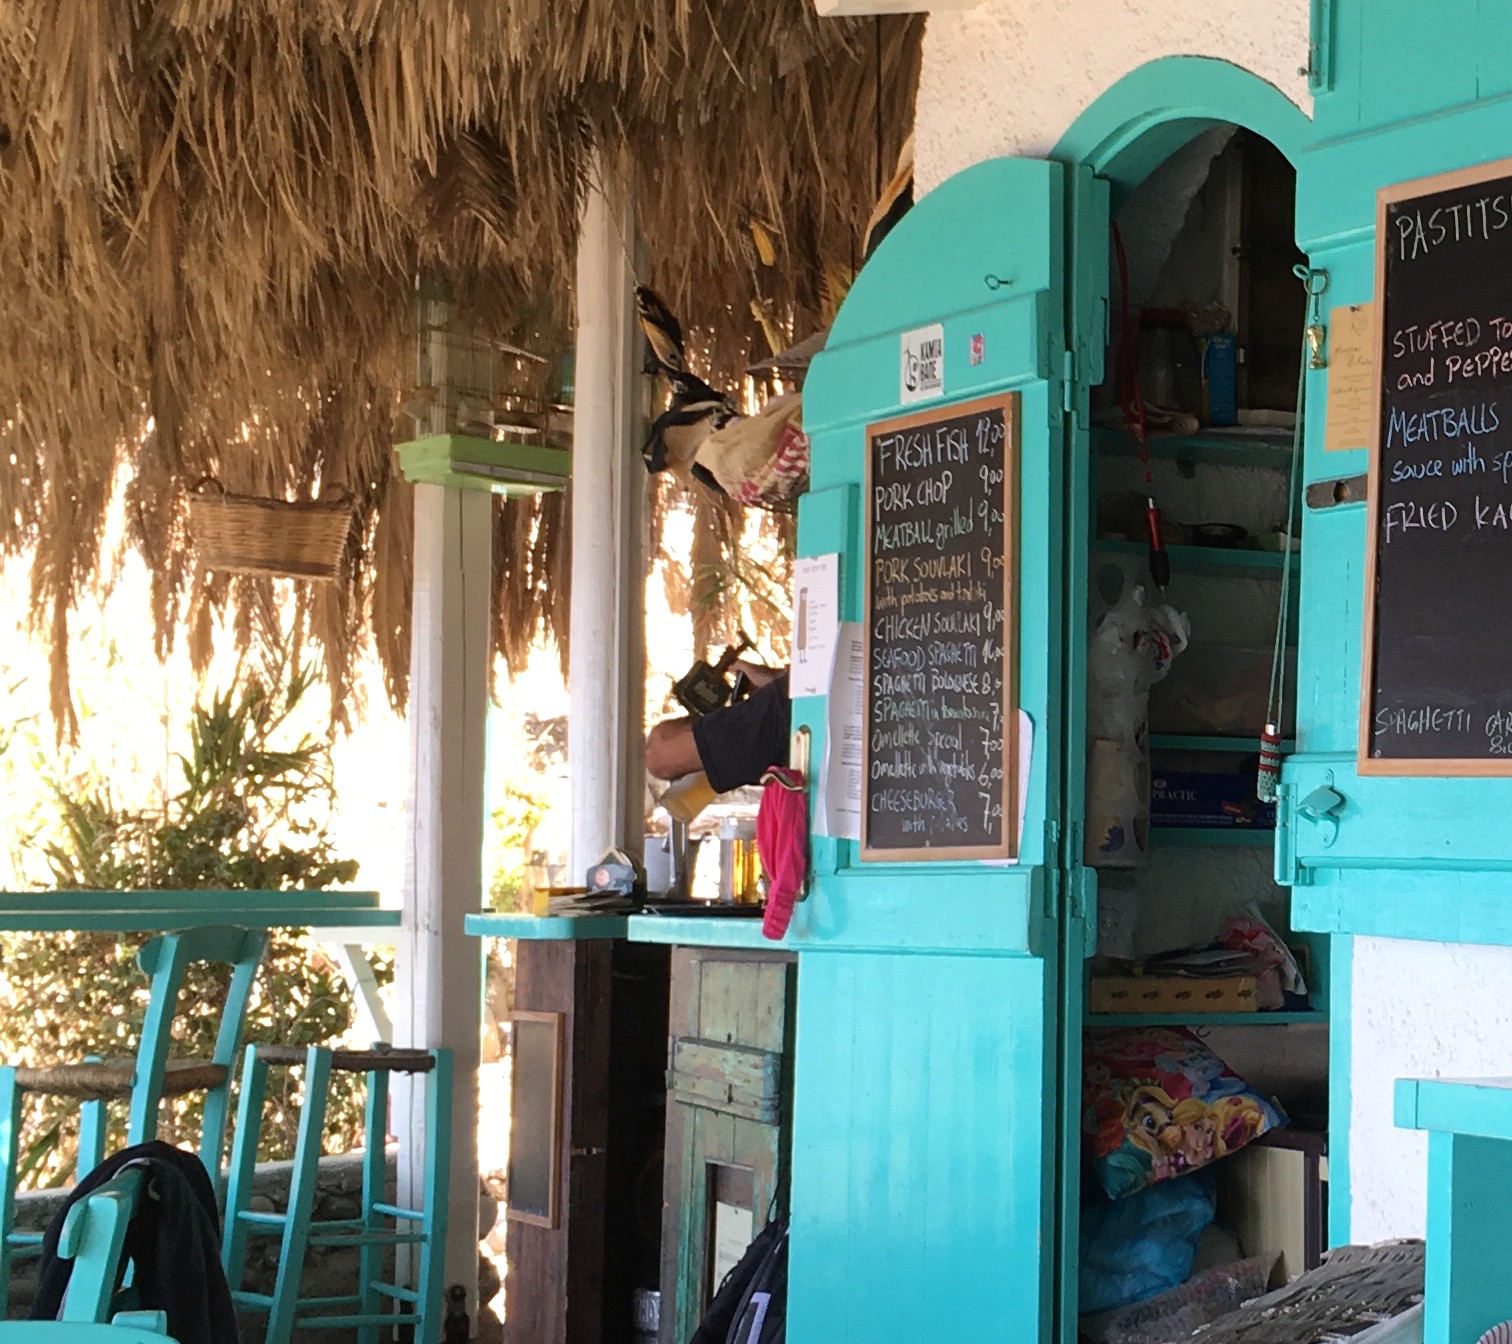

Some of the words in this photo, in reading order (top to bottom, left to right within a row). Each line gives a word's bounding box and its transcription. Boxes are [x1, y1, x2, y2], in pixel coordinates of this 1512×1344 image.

[1392, 317, 1481, 358] STUFFED
[1397, 358, 1435, 390] and
[1386, 401, 1500, 449] MEATBALLS
[880, 432, 933, 476] FRESH
[935, 427, 969, 464] FISH
[1390, 459, 1443, 482] sauce
[1452, 441, 1486, 476] with
[875, 481, 914, 522] PORK
[917, 470, 953, 506] CHOP
[1385, 500, 1458, 544] FRIED
[875, 557, 910, 588] PORK
[874, 612, 931, 643] CHICKEN
[873, 645, 926, 672] SEAFOOD
